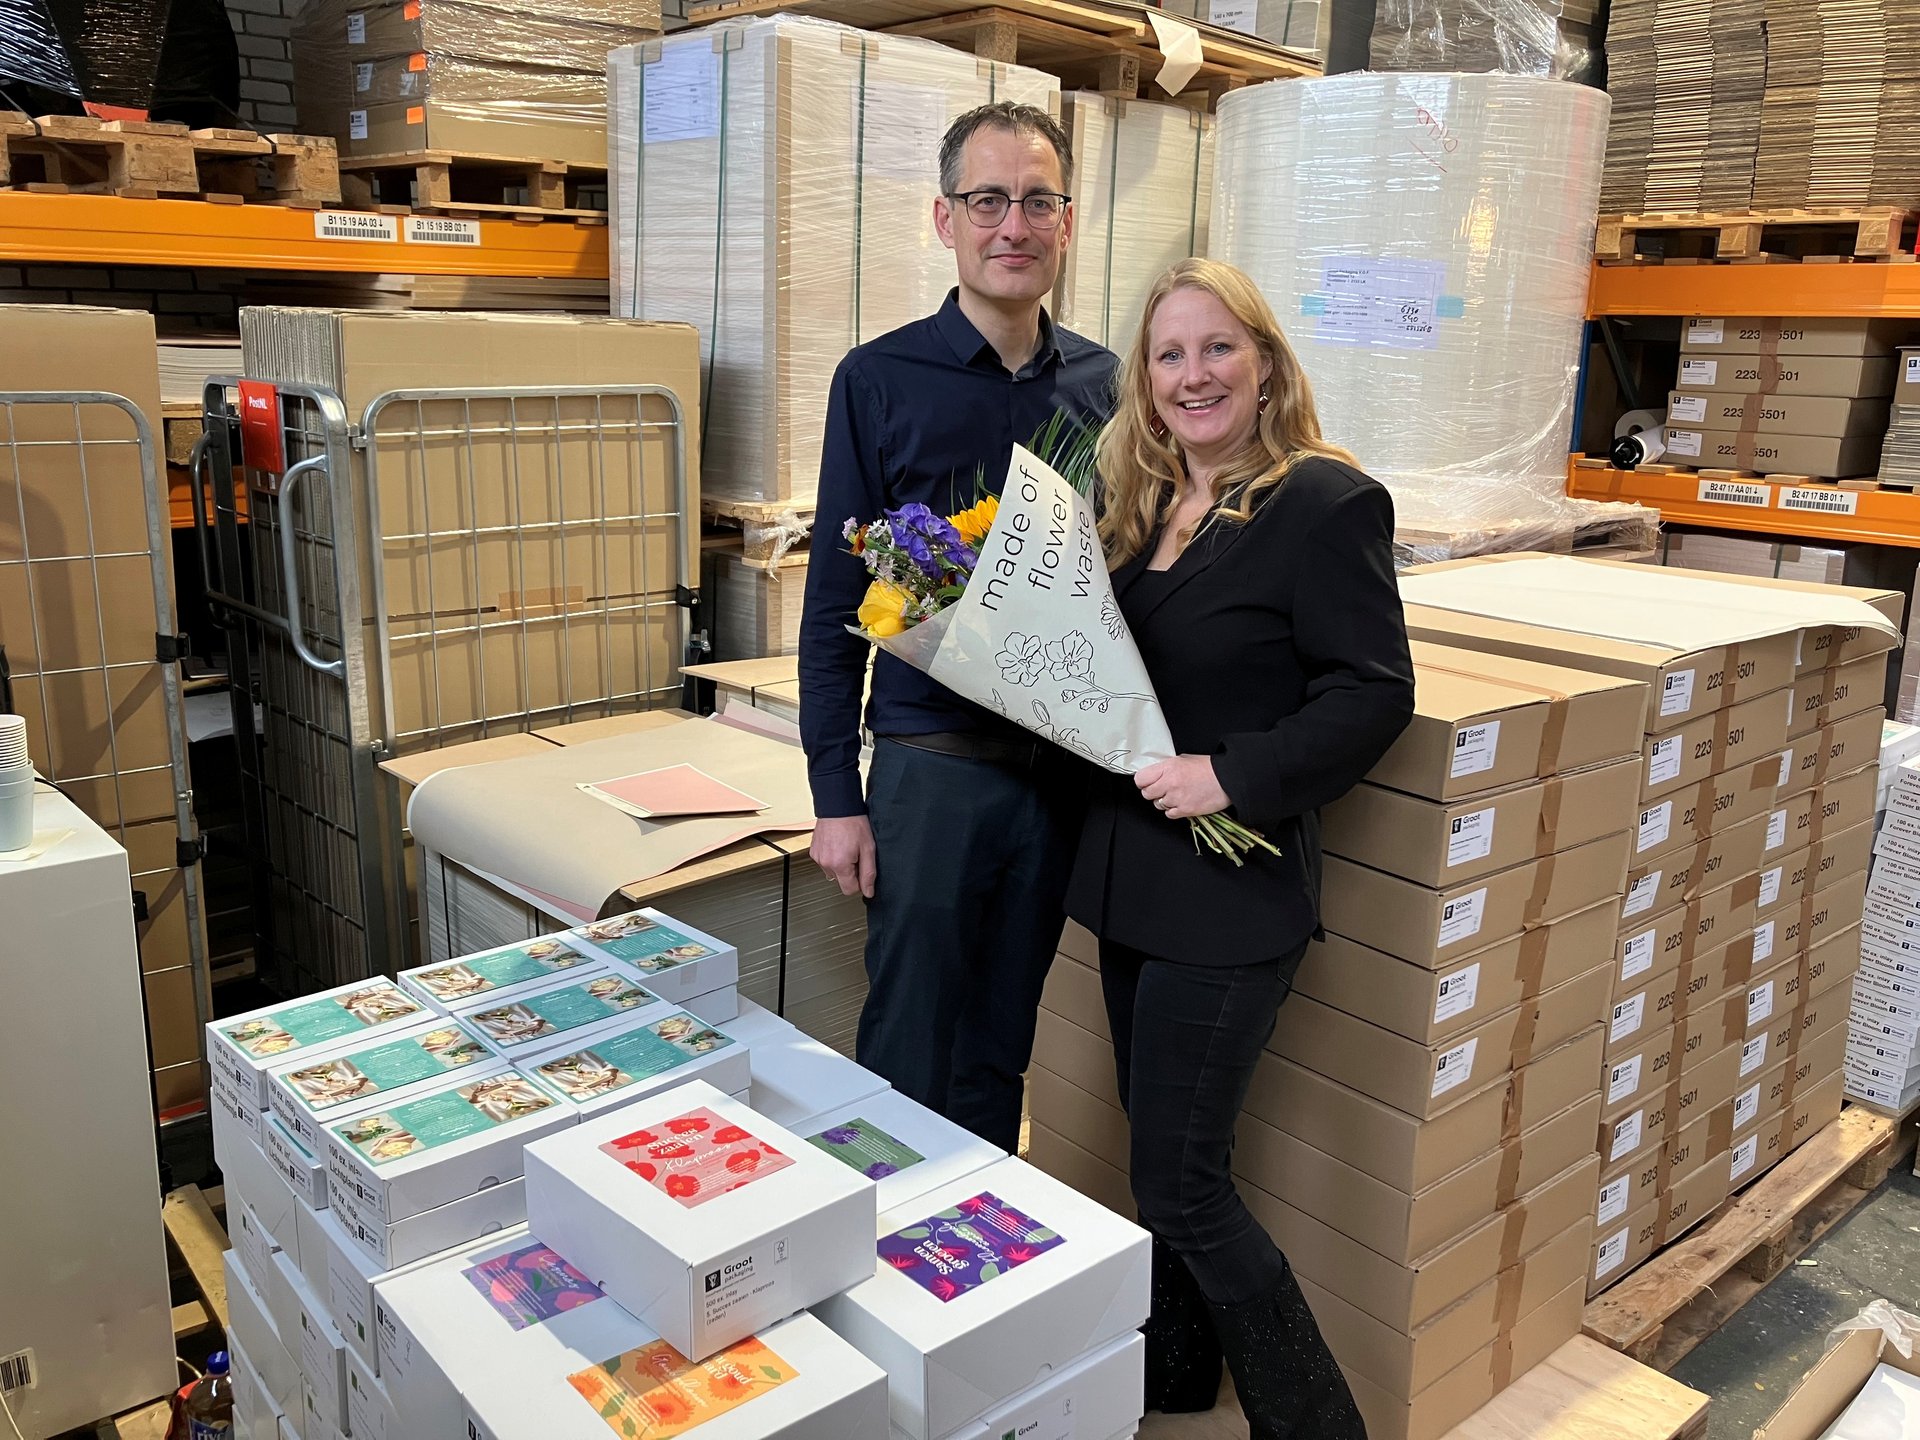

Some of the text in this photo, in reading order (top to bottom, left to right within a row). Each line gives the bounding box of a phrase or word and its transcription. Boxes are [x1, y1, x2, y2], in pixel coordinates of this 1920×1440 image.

[328, 215, 377, 227] B1 15 19 AA 03
[417, 221, 461, 231] B1 15 19 BB 03
[1792, 490, 1800, 498] B2
[1802, 491, 1810, 499] 47
[1820, 492, 1829, 500] BB
[1830, 494, 1837, 502] 01
[980, 464, 1039, 611] made of
[1028, 488, 1067, 590] flower
[1070, 511, 1093, 597] waste
[1468, 728, 1485, 738] Groot
[1660, 739, 1672, 748] Groot
[1893, 799, 1914, 808] Forever
[1649, 806, 1662, 816] Groot
[1463, 814, 1480, 823] Groot
[1890, 824, 1911, 833] Forever
[1881, 844, 1901, 854] Forever
[1881, 867, 1902, 876] Forever
[1640, 875, 1652, 884] Groot
[1871, 890, 1892, 900] Forever
[1456, 898, 1472, 909] Groot
[1865, 908, 1885, 917] Forever
[1633, 936, 1645, 946] Groot
[1450, 974, 1466, 986] Groot
[1622, 1000, 1635, 1010] Groot
[1448, 1048, 1464, 1060] Groot
[646, 1128, 698, 1150] Succes
[657, 1134, 704, 1155] zaaien
[329, 1144, 338, 1159] 100
[364, 1189, 376, 1201] Groot
[365, 1231, 377, 1244] Groot
[914, 1245, 953, 1275] Samen
[923, 1239, 970, 1270] groeien
[724, 1256, 752, 1275] Groot
[725, 1265, 753, 1283] packaging
[713, 1302, 731, 1314] Succes
[384, 1314, 396, 1334] Groot
[1018, 1421, 1038, 1436] Groot
